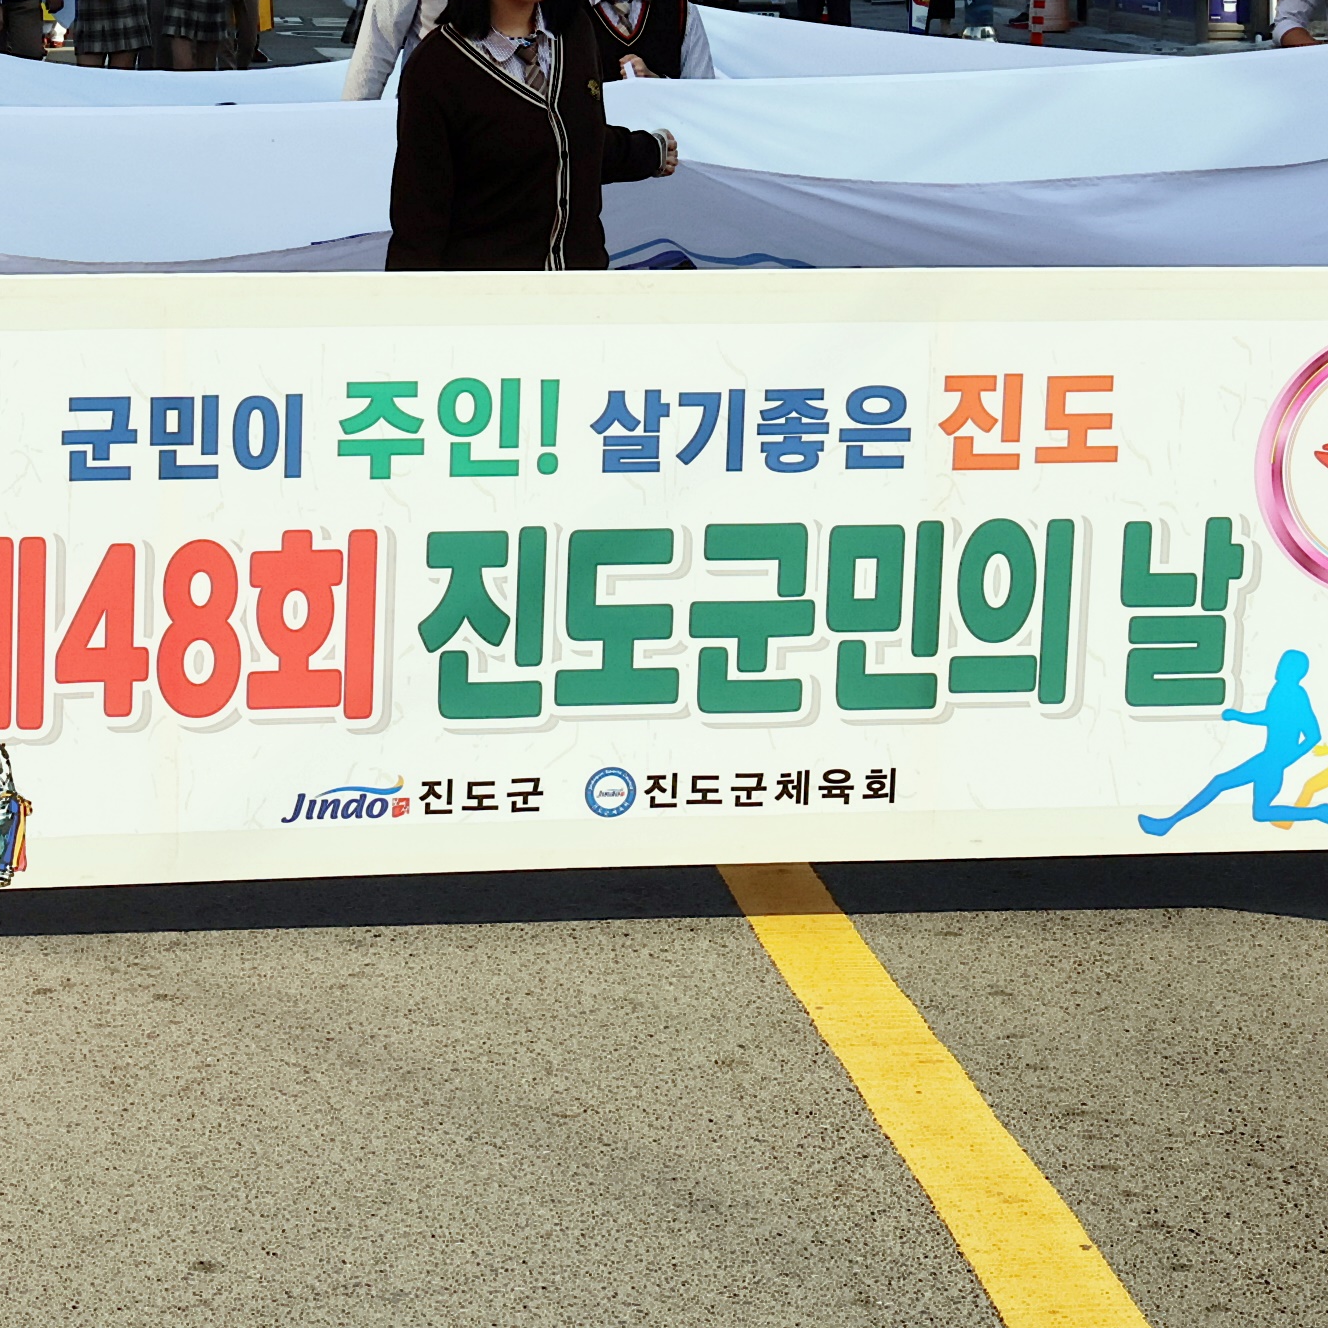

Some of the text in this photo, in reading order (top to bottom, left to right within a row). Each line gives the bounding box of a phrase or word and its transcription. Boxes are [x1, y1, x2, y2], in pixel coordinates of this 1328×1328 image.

[61, 373, 1119, 482] 군민이 주인! 살기좋은 진도
[417, 517, 1076, 720] 진도군민의
[1120, 516, 1245, 709] 날
[281, 787, 390, 824] Jindo
[418, 777, 545, 815] 진도군
[643, 767, 897, 809] 진도군체육회
